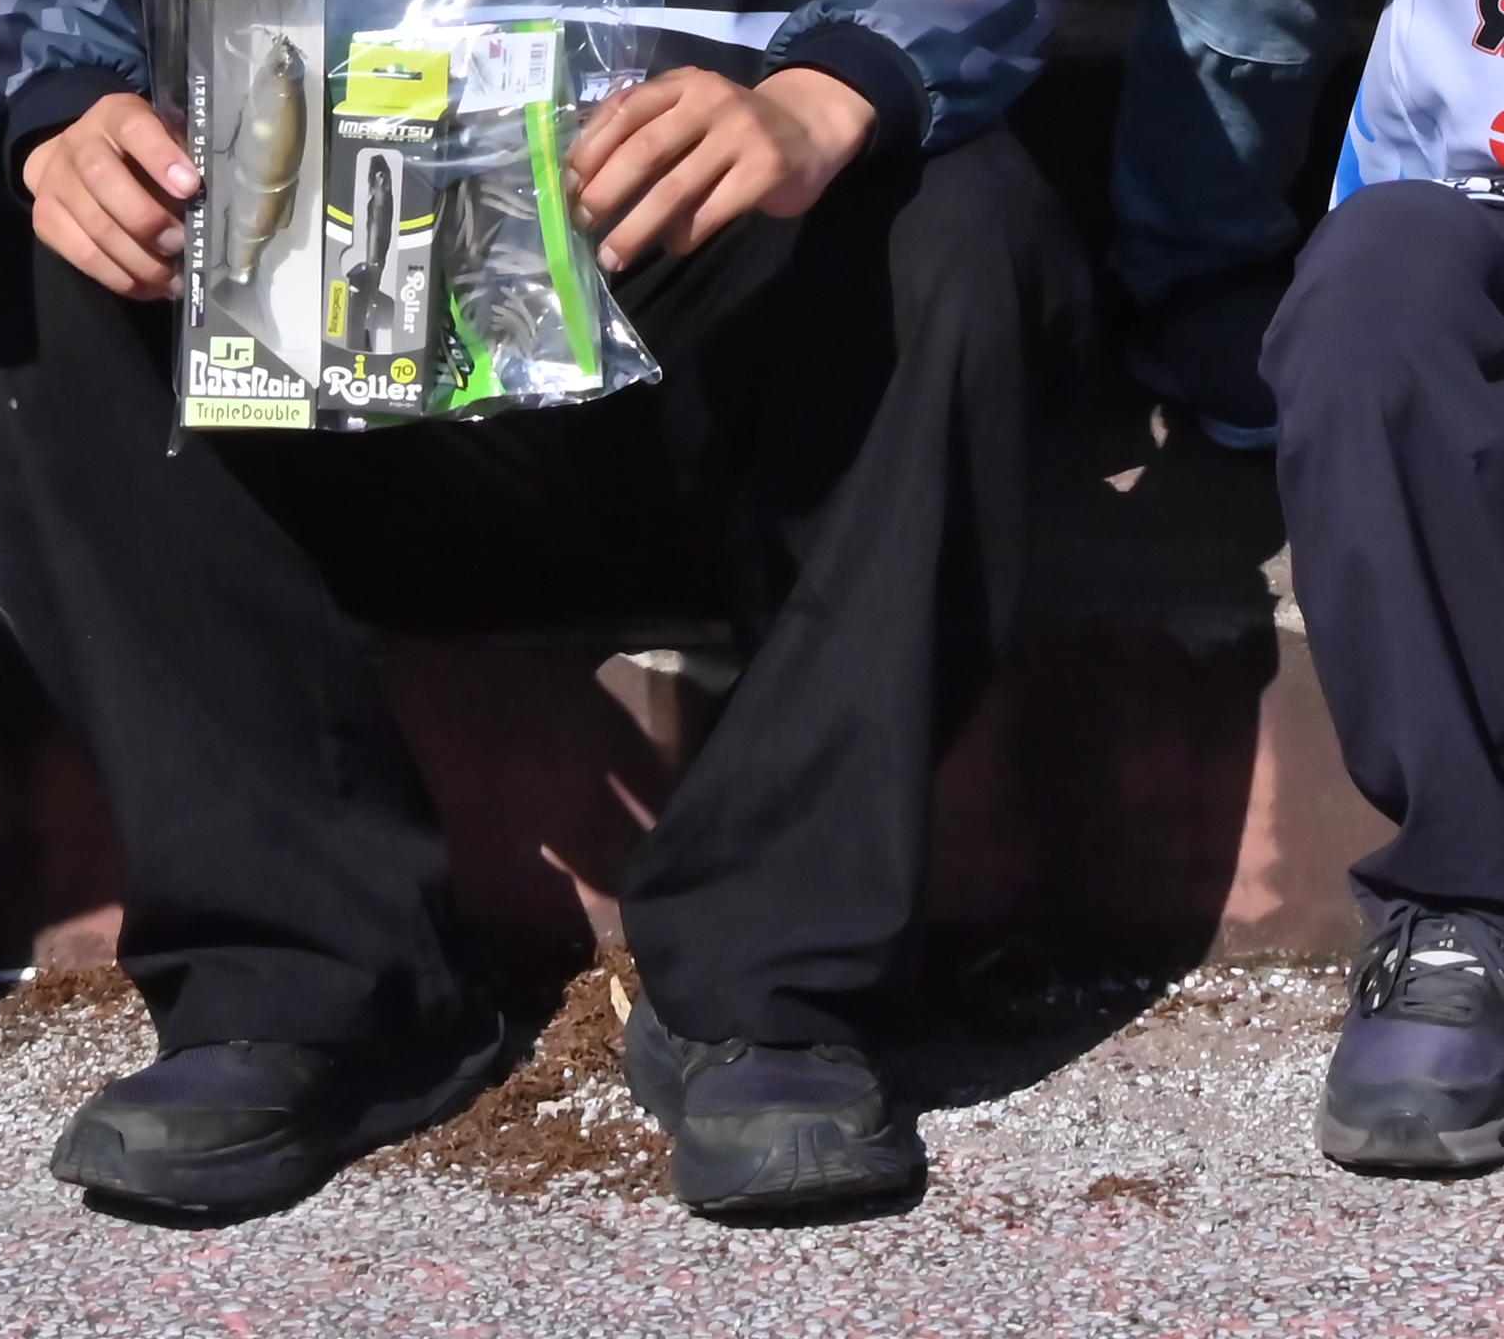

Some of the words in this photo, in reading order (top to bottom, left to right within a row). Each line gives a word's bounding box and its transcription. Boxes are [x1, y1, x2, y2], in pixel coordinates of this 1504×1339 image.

[338, 120, 434, 139] IMAKATSU
[393, 363, 415, 378] 70
[323, 365, 423, 407] Roller
[196, 402, 300, 422] TripleDouble
